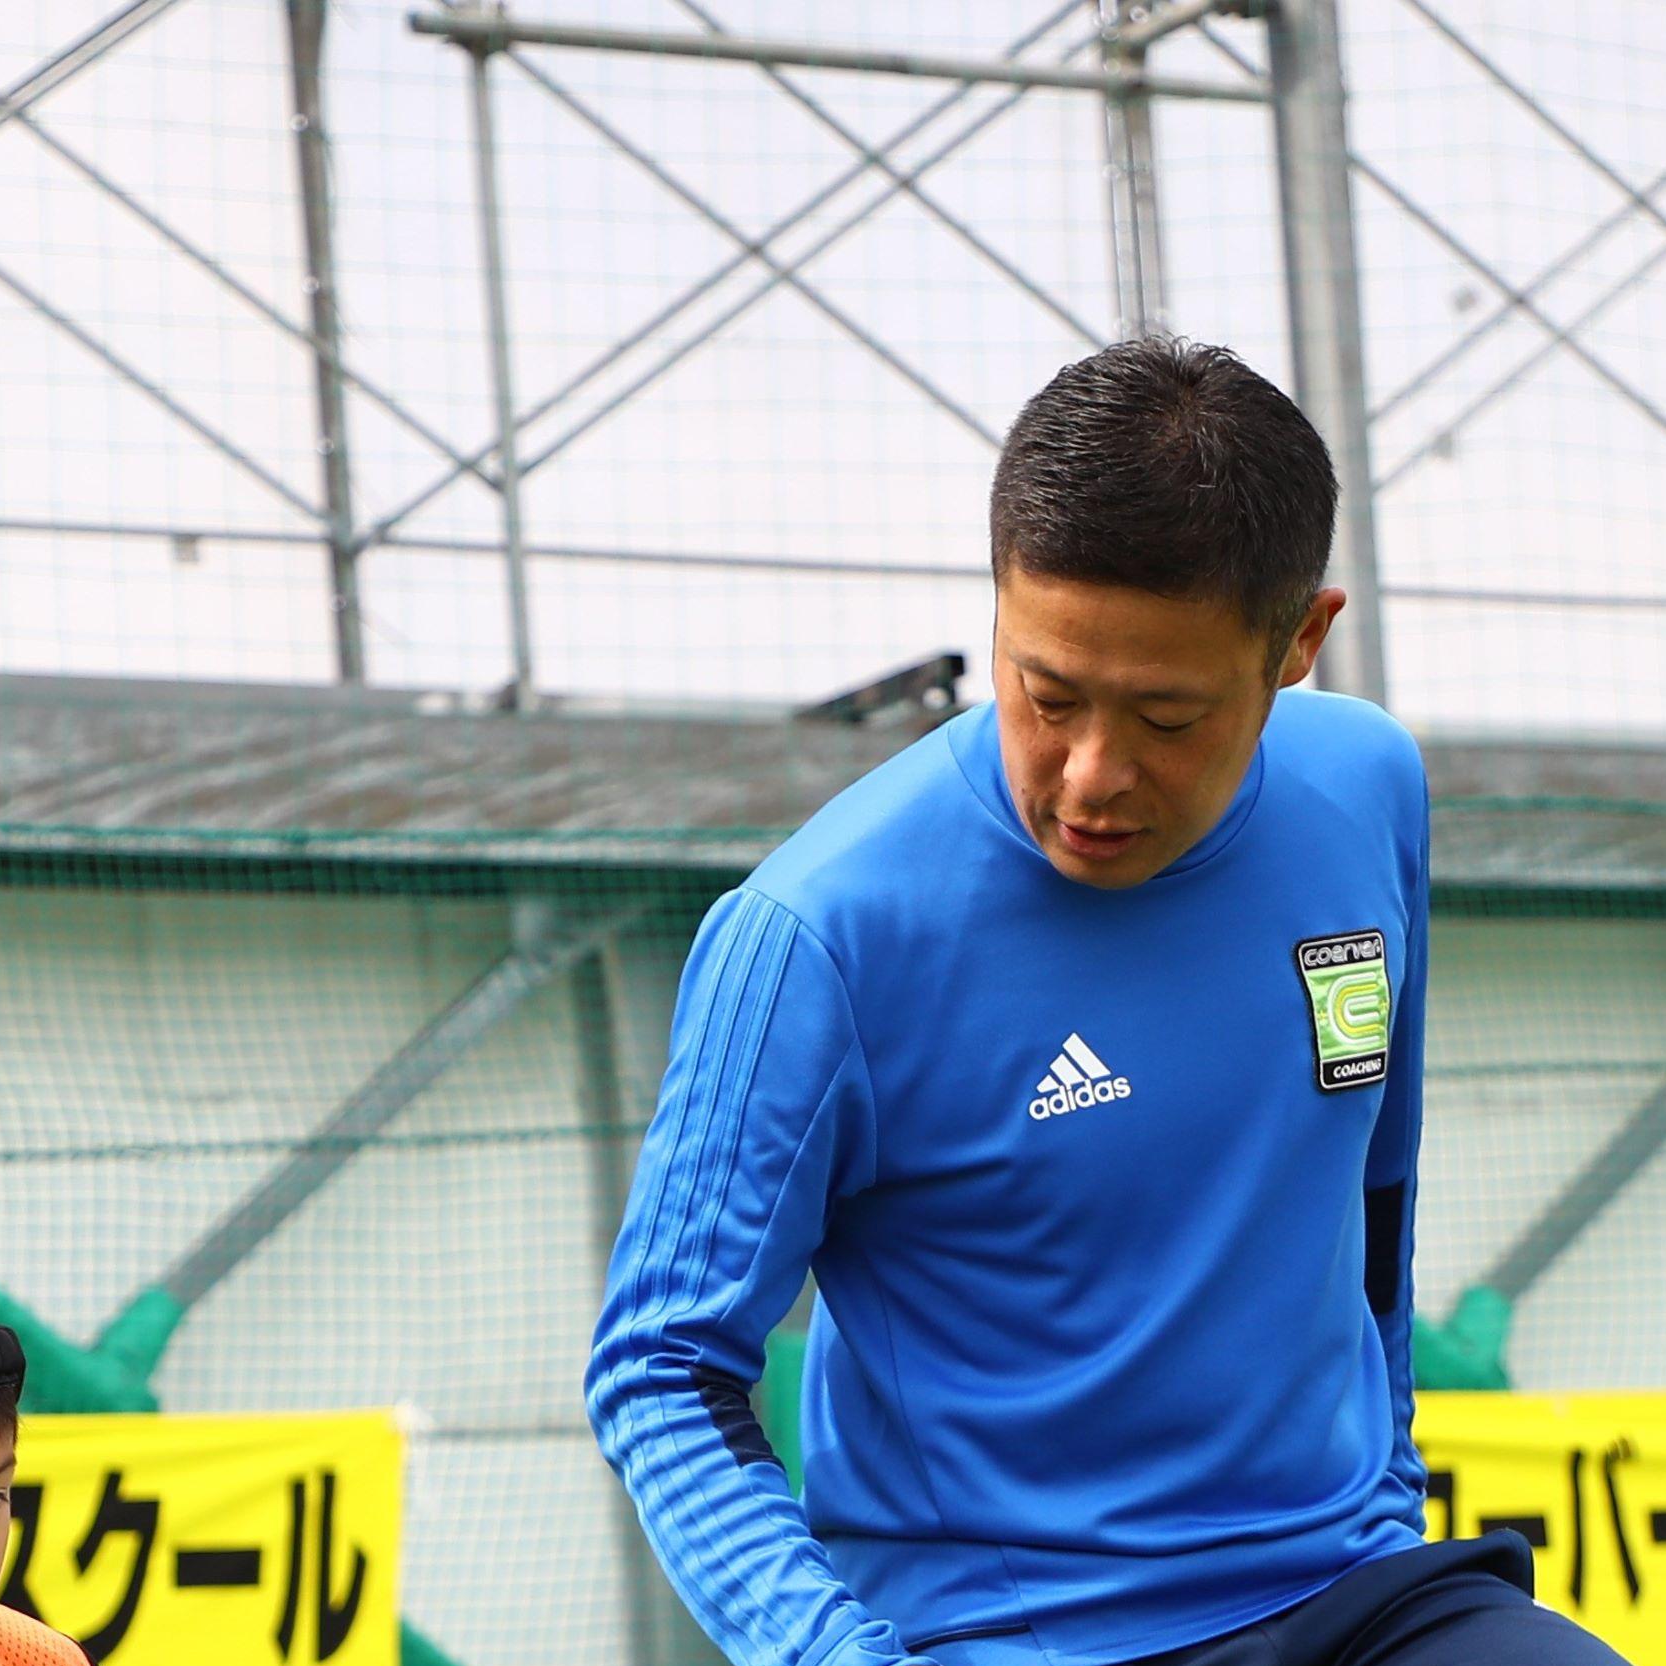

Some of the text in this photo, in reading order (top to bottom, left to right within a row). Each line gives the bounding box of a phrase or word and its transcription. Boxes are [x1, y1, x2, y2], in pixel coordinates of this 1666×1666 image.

[1303, 938, 1380, 967] coerver
[1333, 1057, 1382, 1079] COACHING
[1028, 1075, 1131, 1121] adidas
